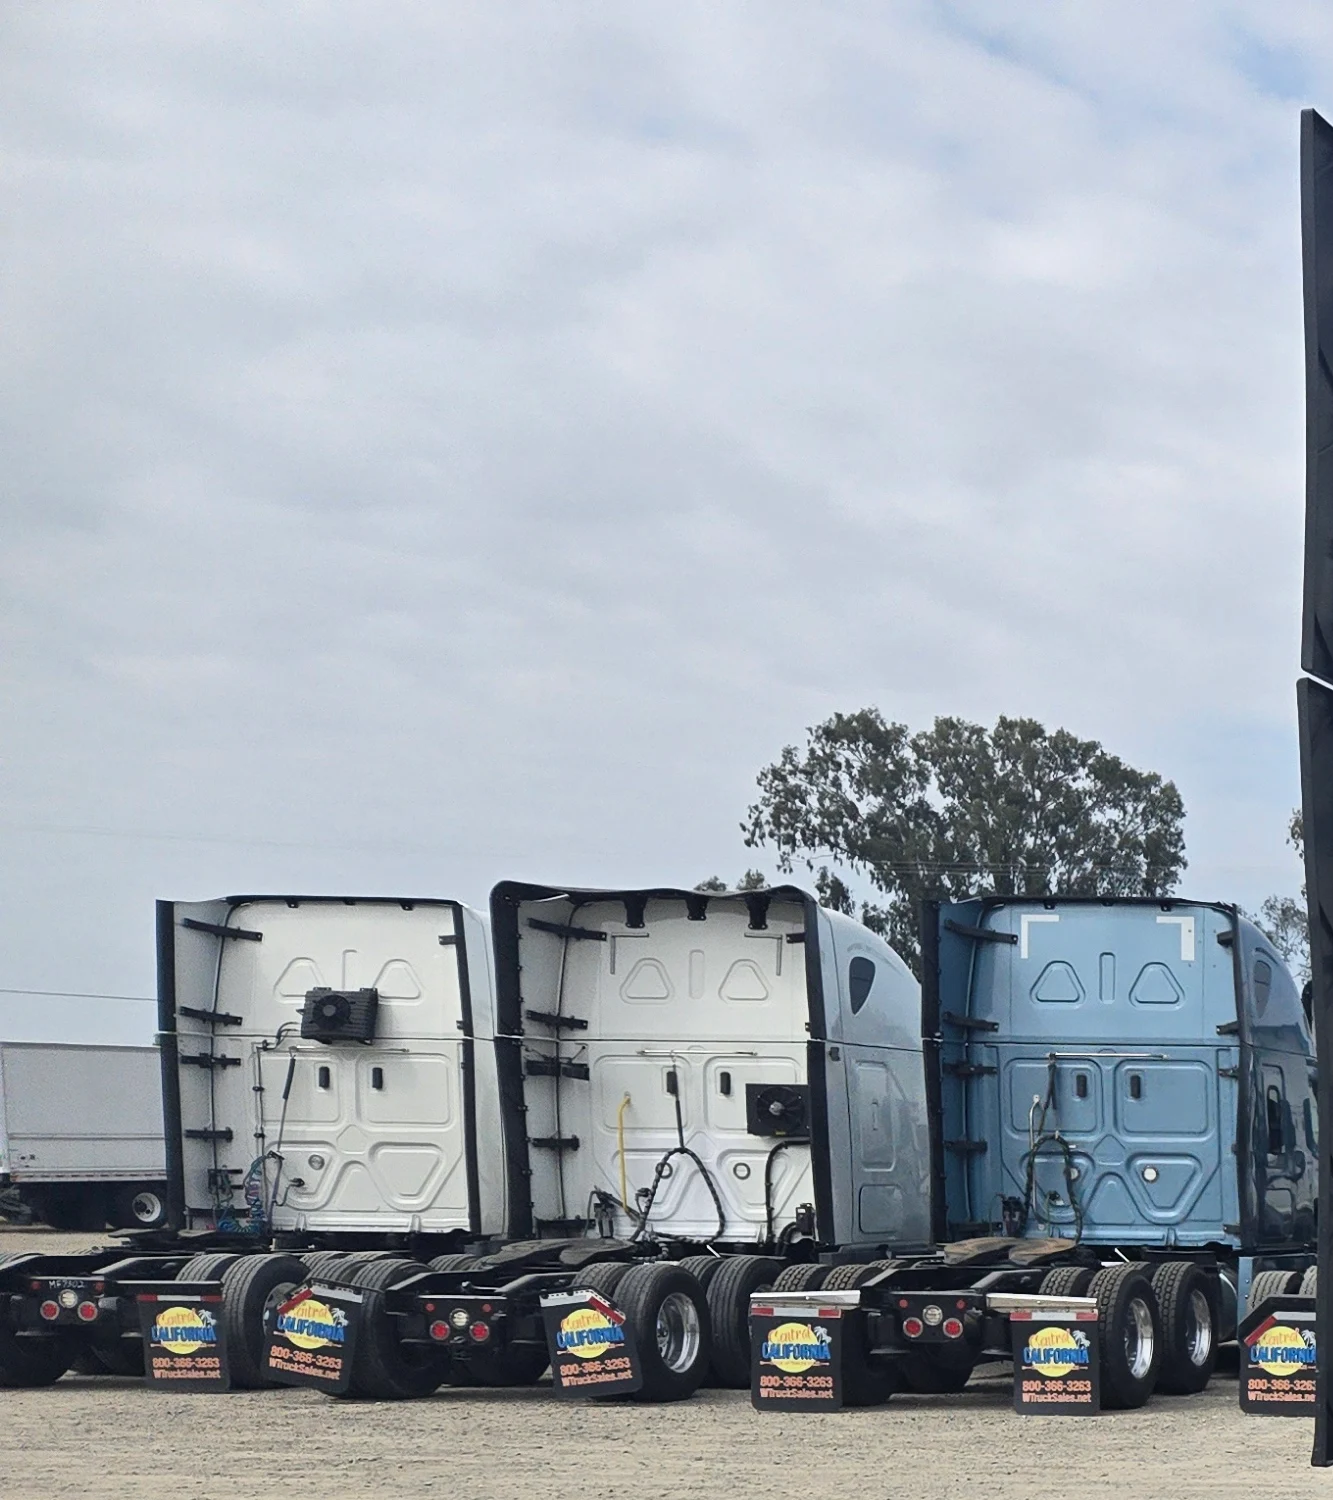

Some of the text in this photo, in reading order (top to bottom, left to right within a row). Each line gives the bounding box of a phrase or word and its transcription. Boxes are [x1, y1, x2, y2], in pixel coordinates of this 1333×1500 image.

[151, 1325, 217, 1341] CALIFORNIA
[277, 1315, 344, 1341] CALIFORNIA
[557, 1326, 624, 1348] CALIFORNIA
[762, 1342, 831, 1360] CALIFORNIA
[1023, 1347, 1089, 1364] CALIFORNIA
[1248, 1379, 1316, 1390] 800-366-326
